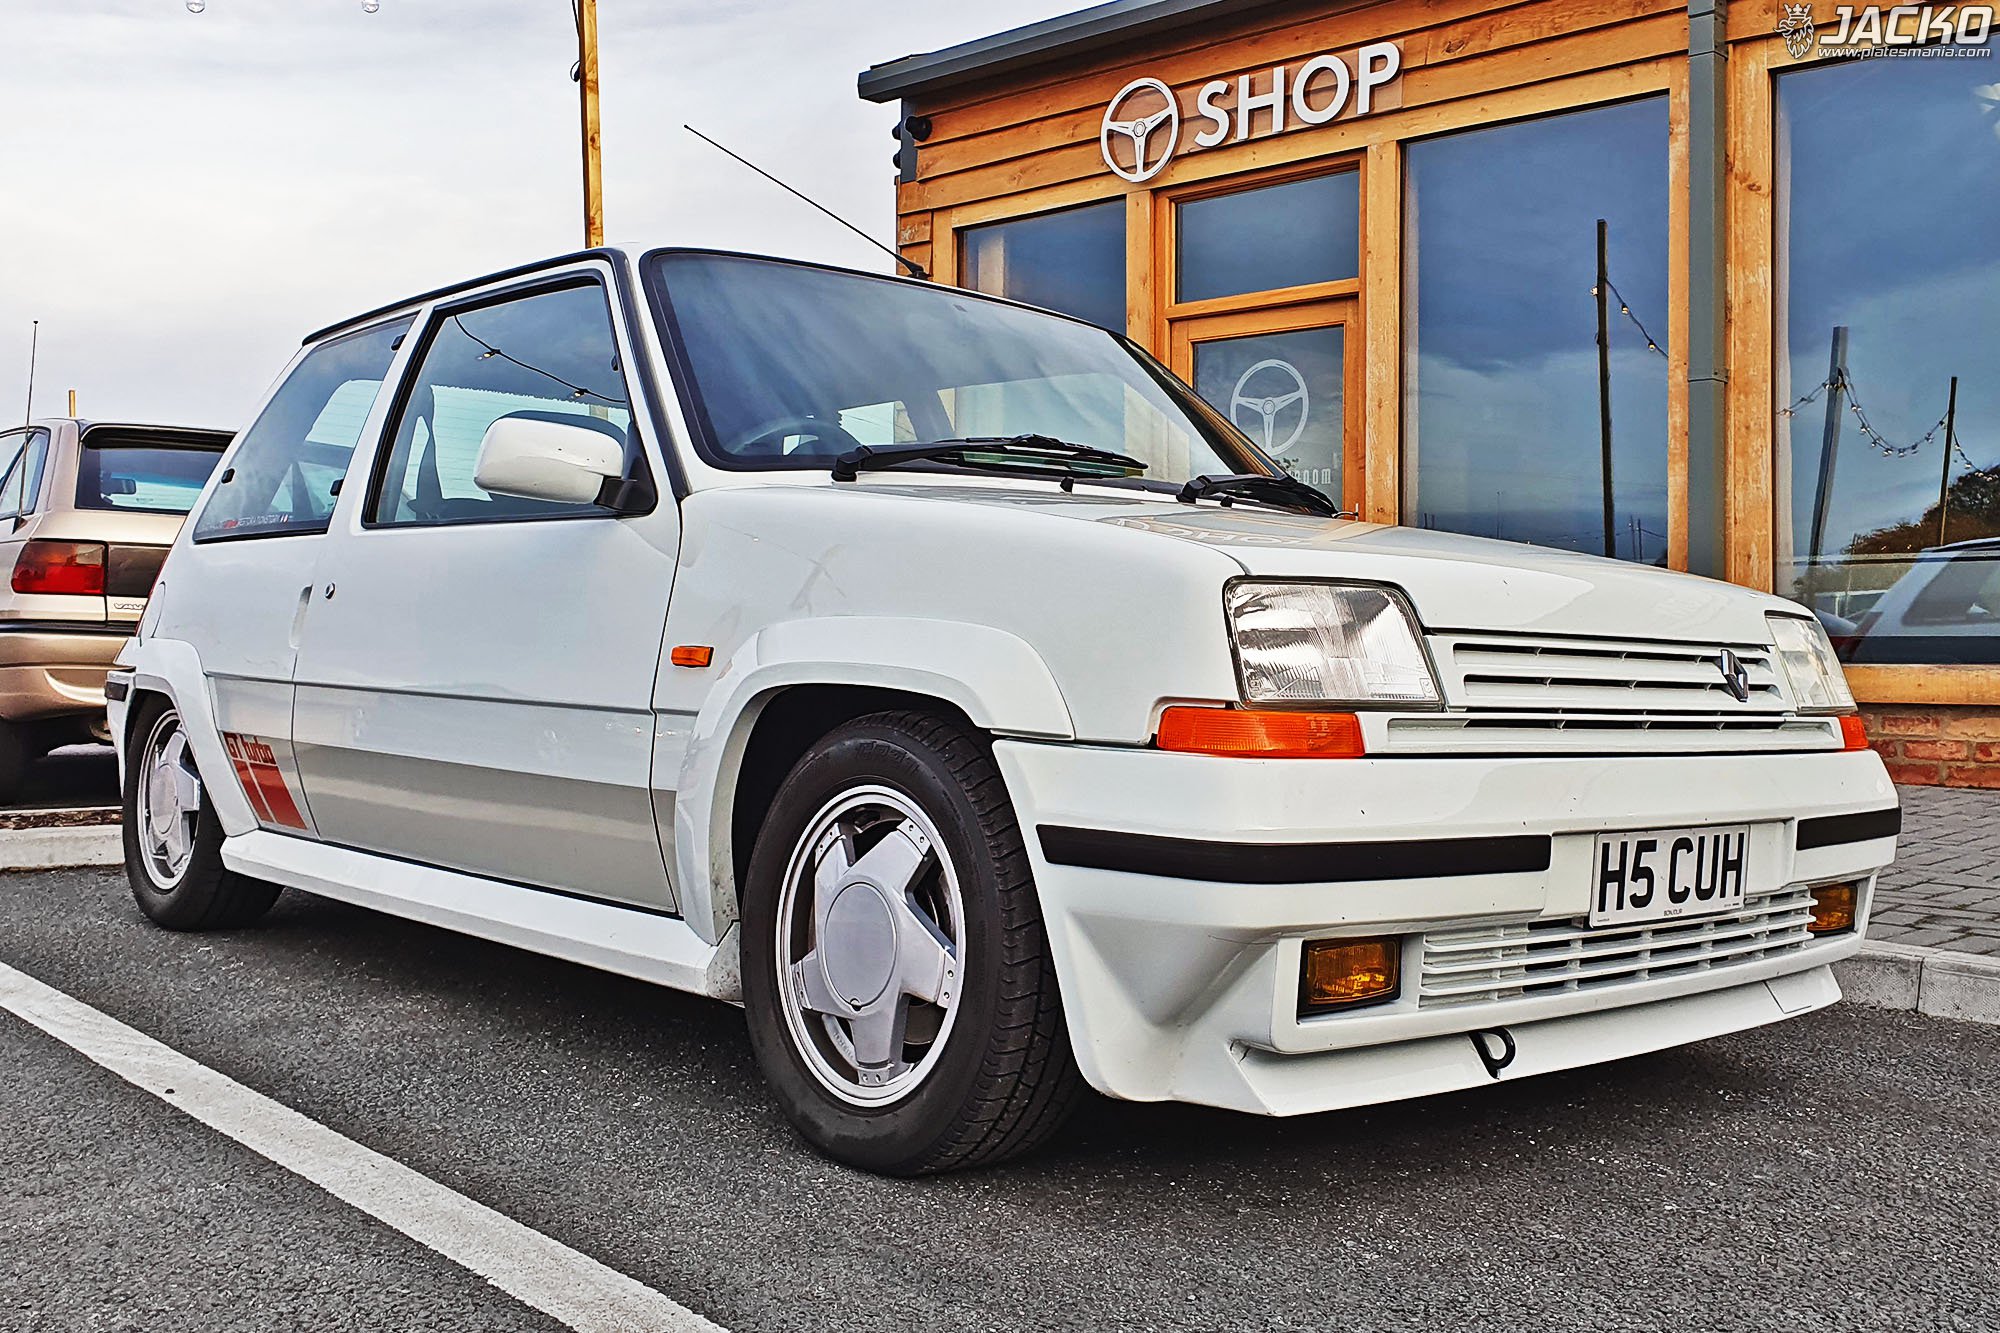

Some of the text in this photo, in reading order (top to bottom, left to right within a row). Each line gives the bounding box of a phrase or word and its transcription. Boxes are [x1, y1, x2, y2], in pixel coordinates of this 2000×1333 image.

[1194, 41, 1400, 147] SHOP
[222, 731, 277, 765] GT turbo
[1597, 832, 1745, 913] H5 CUH
